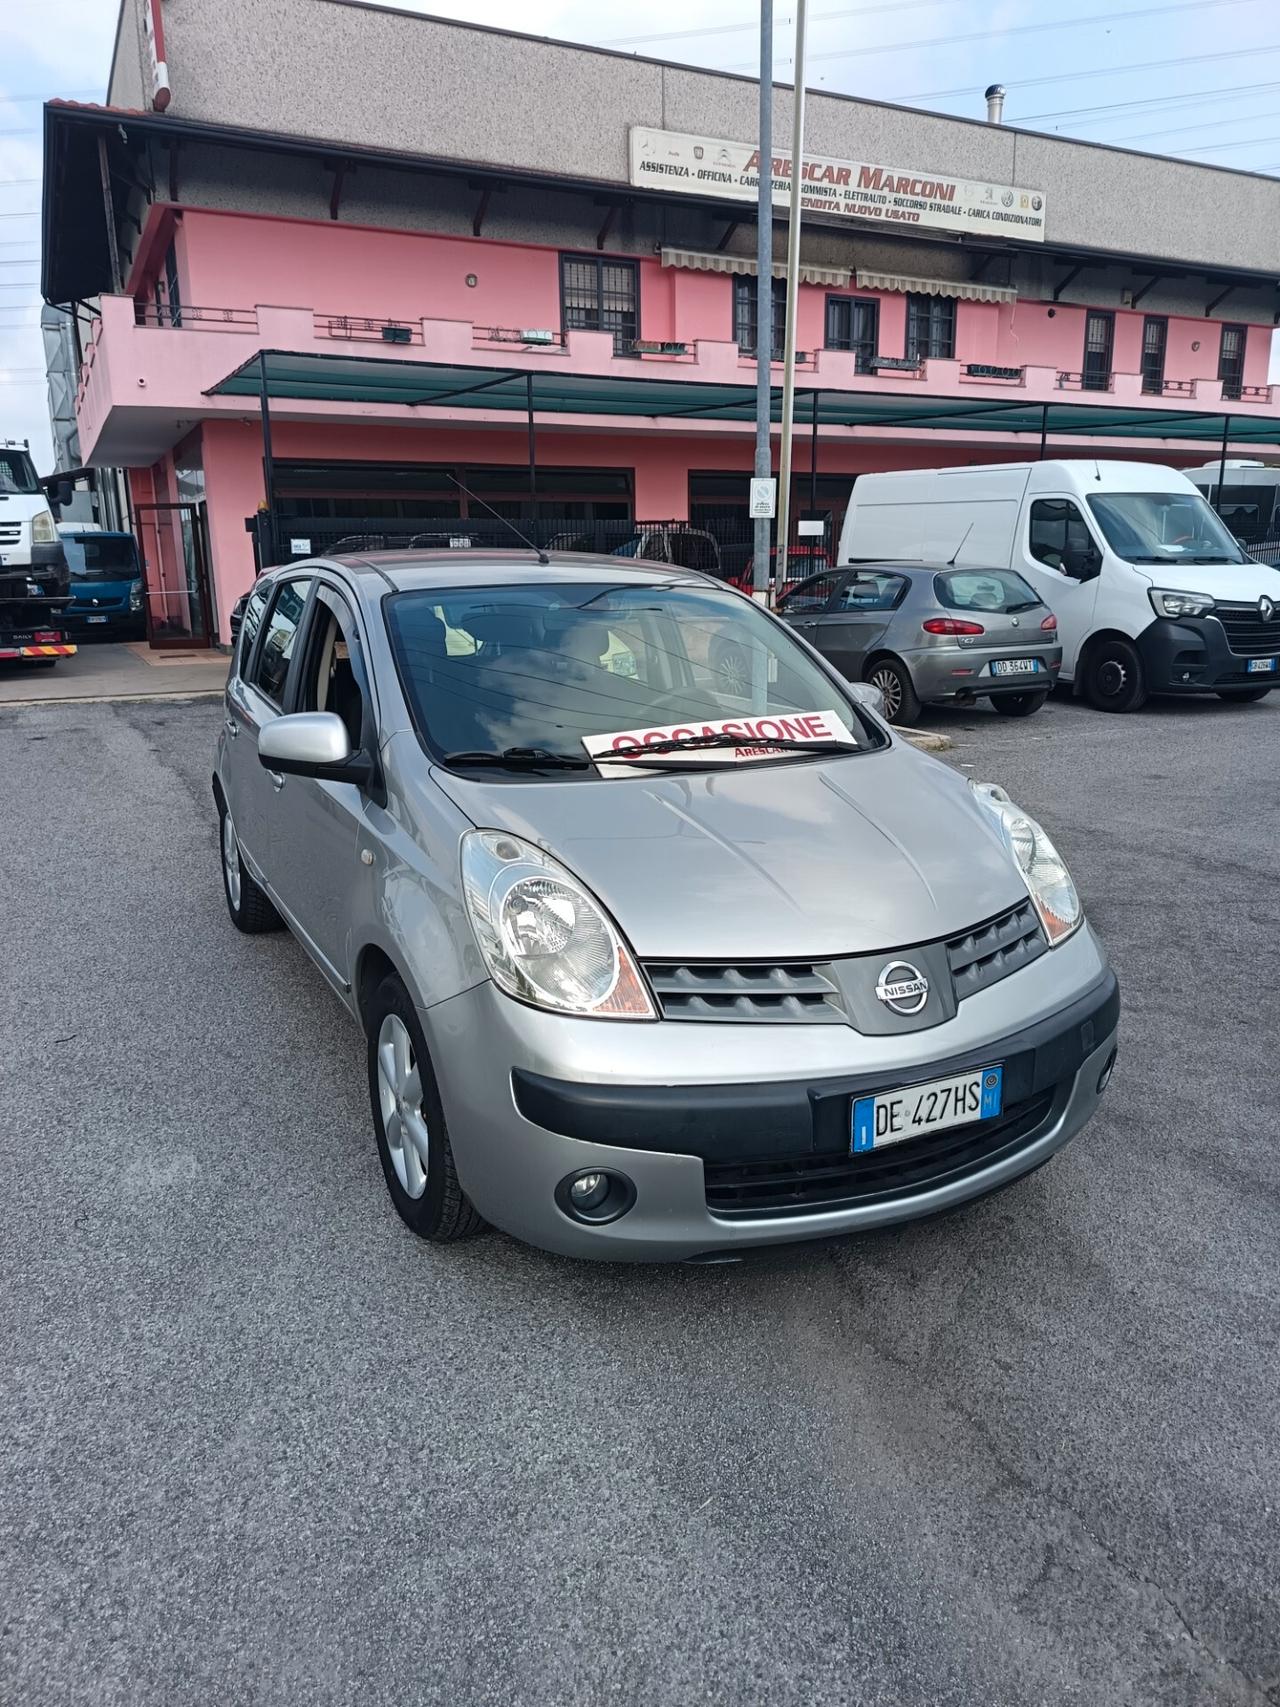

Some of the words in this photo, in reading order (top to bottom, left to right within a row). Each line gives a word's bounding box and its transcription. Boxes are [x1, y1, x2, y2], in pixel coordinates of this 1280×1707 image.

[639, 161, 690, 178] ASSISTENZA
[697, 169, 732, 184] OFFICINA
[740, 175, 792, 192] CARRZERIA
[844, 190, 888, 204] ELETTRAUTO
[893, 197, 928, 211] SOCCORSO
[929, 202, 962, 216] STRADALE
[967, 207, 991, 221] CARICA
[992, 211, 1042, 227] CONDIZIONATORI
[857, 166, 956, 202] MARCONI
[801, 197, 840, 212] ENDITA
[843, 203, 882, 217] NUOVO
[885, 209, 920, 223] USATO
[884, 981, 928, 997] NISSAN
[875, 1099, 904, 1137] DE
[911, 1081, 981, 1126] 427HS
